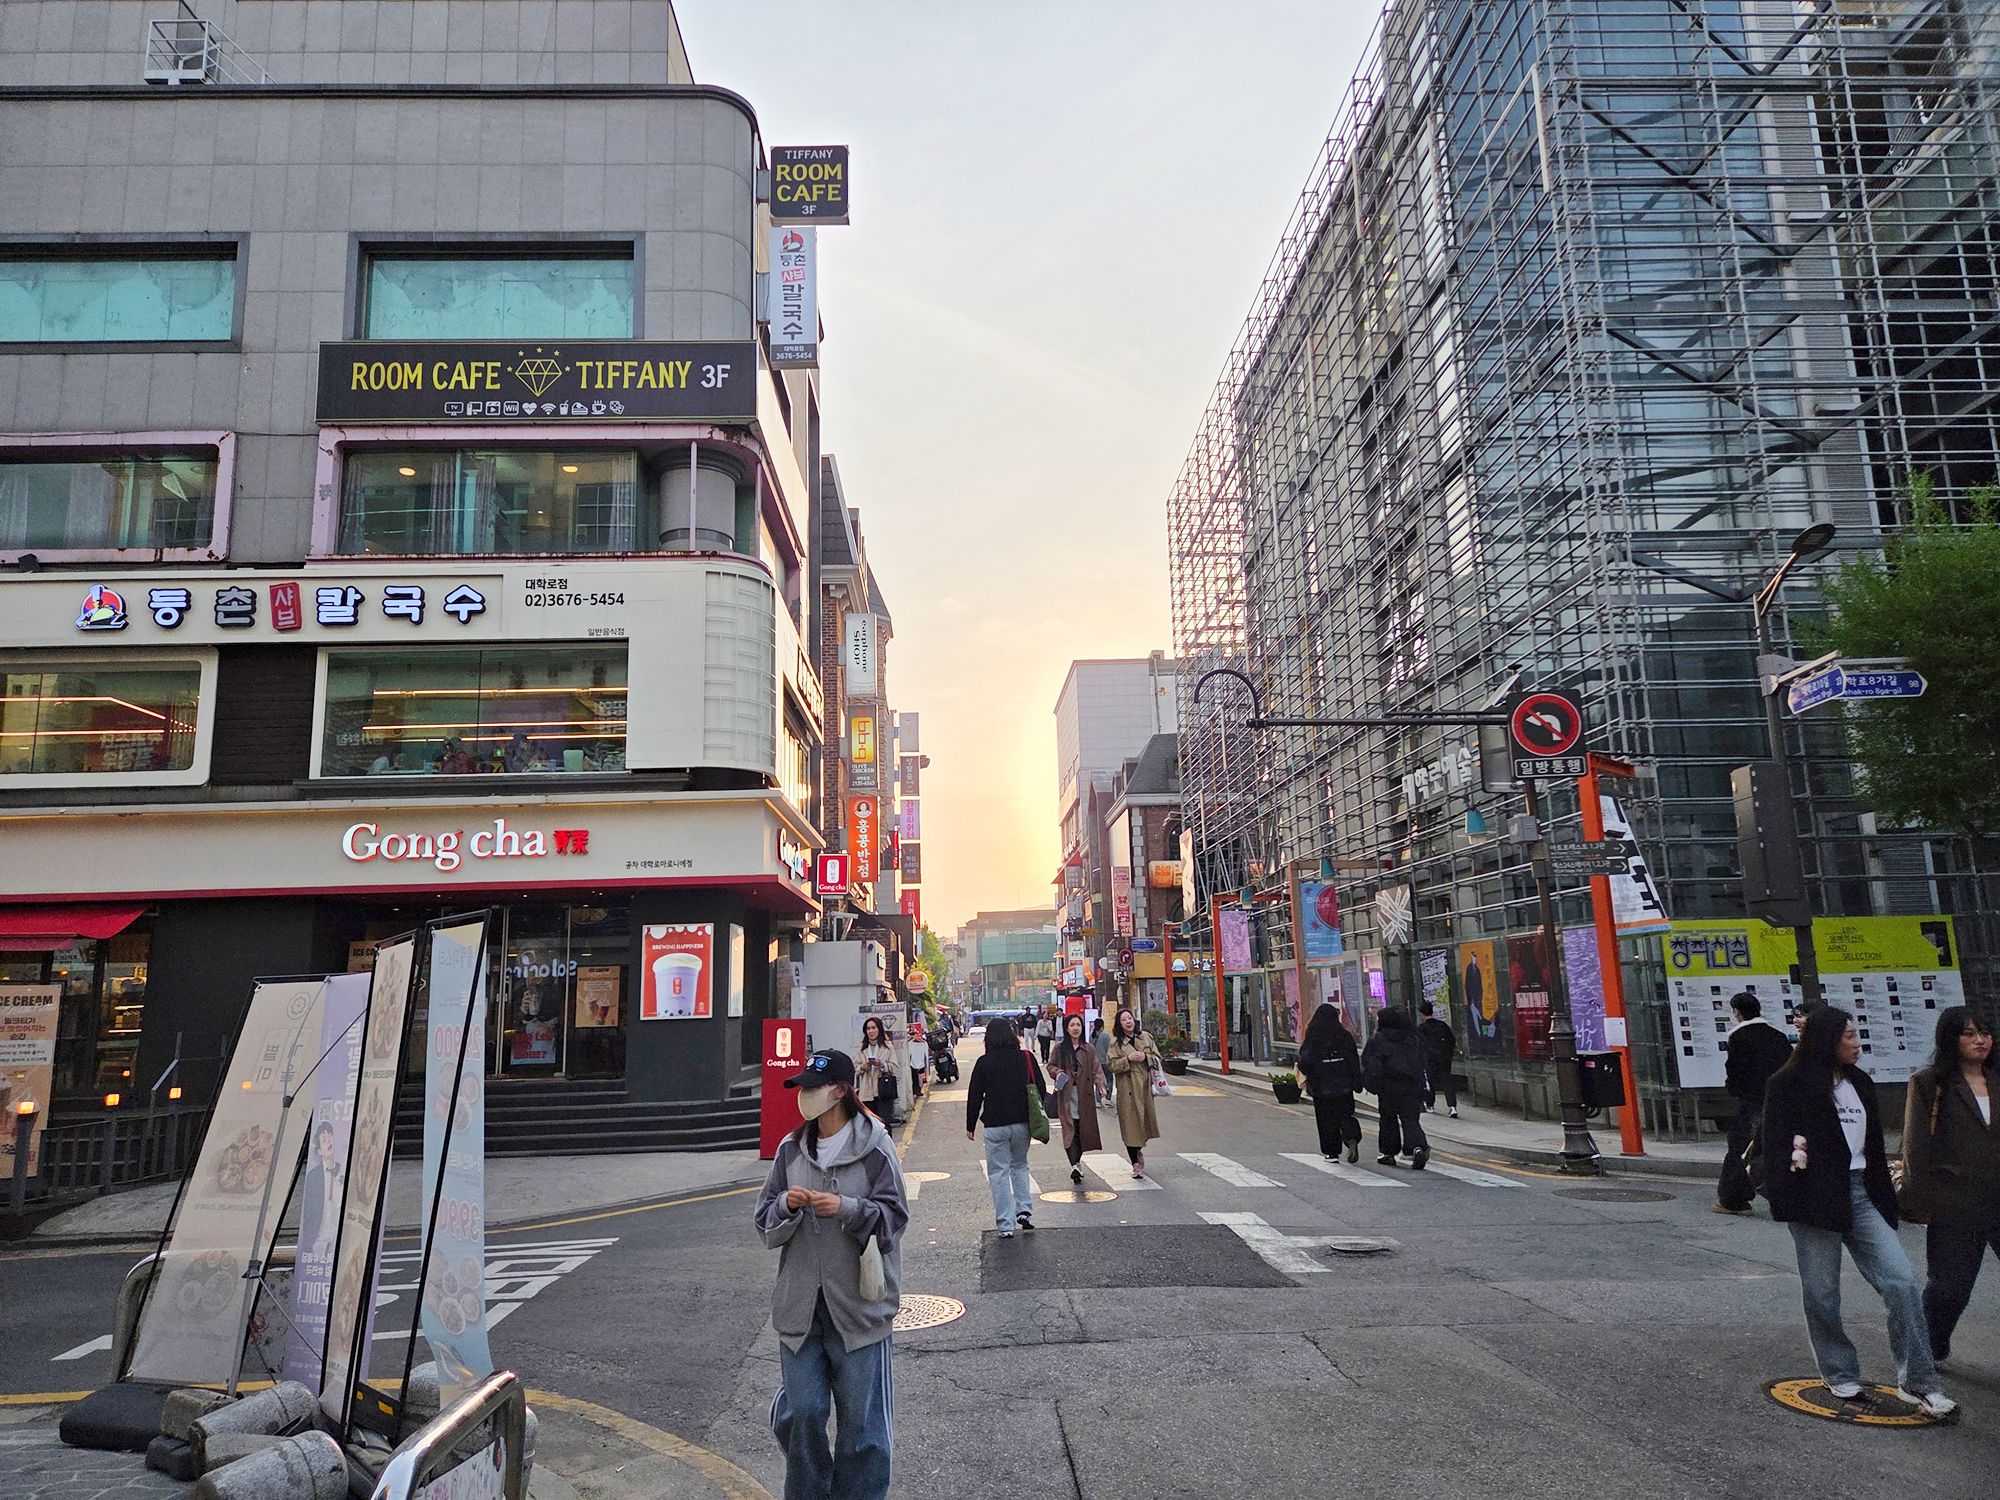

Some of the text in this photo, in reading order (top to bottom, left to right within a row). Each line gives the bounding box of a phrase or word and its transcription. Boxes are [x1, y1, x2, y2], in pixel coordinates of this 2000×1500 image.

[785, 149, 833, 160] TIFFANY
[776, 163, 842, 182] ROOM
[776, 184, 841, 202] CAFE
[801, 205, 816, 215] 3F
[775, 352, 813, 360] 3676-5454
[351, 361, 731, 390] ROOM CAFE TIFFANY 3F
[525, 578, 568, 590] 대학로점
[524, 592, 625, 607] 02)3676-5454
[587, 627, 625, 637] 일반음식점
[1845, 674, 1898, 688] 학로8가길
[1844, 687, 1874, 695] ehak-ro
[1520, 759, 1582, 776] 일방통행
[341, 818, 547, 871] Gong cha
[856, 818, 870, 879] 홍콩반점
[625, 860, 639, 869] 공차
[818, 884, 836, 892] Gong
[1842, 953, 1882, 961] SELECTION
[13, 995, 53, 1007] CREAM
[767, 1058, 800, 1069] Gong cha
